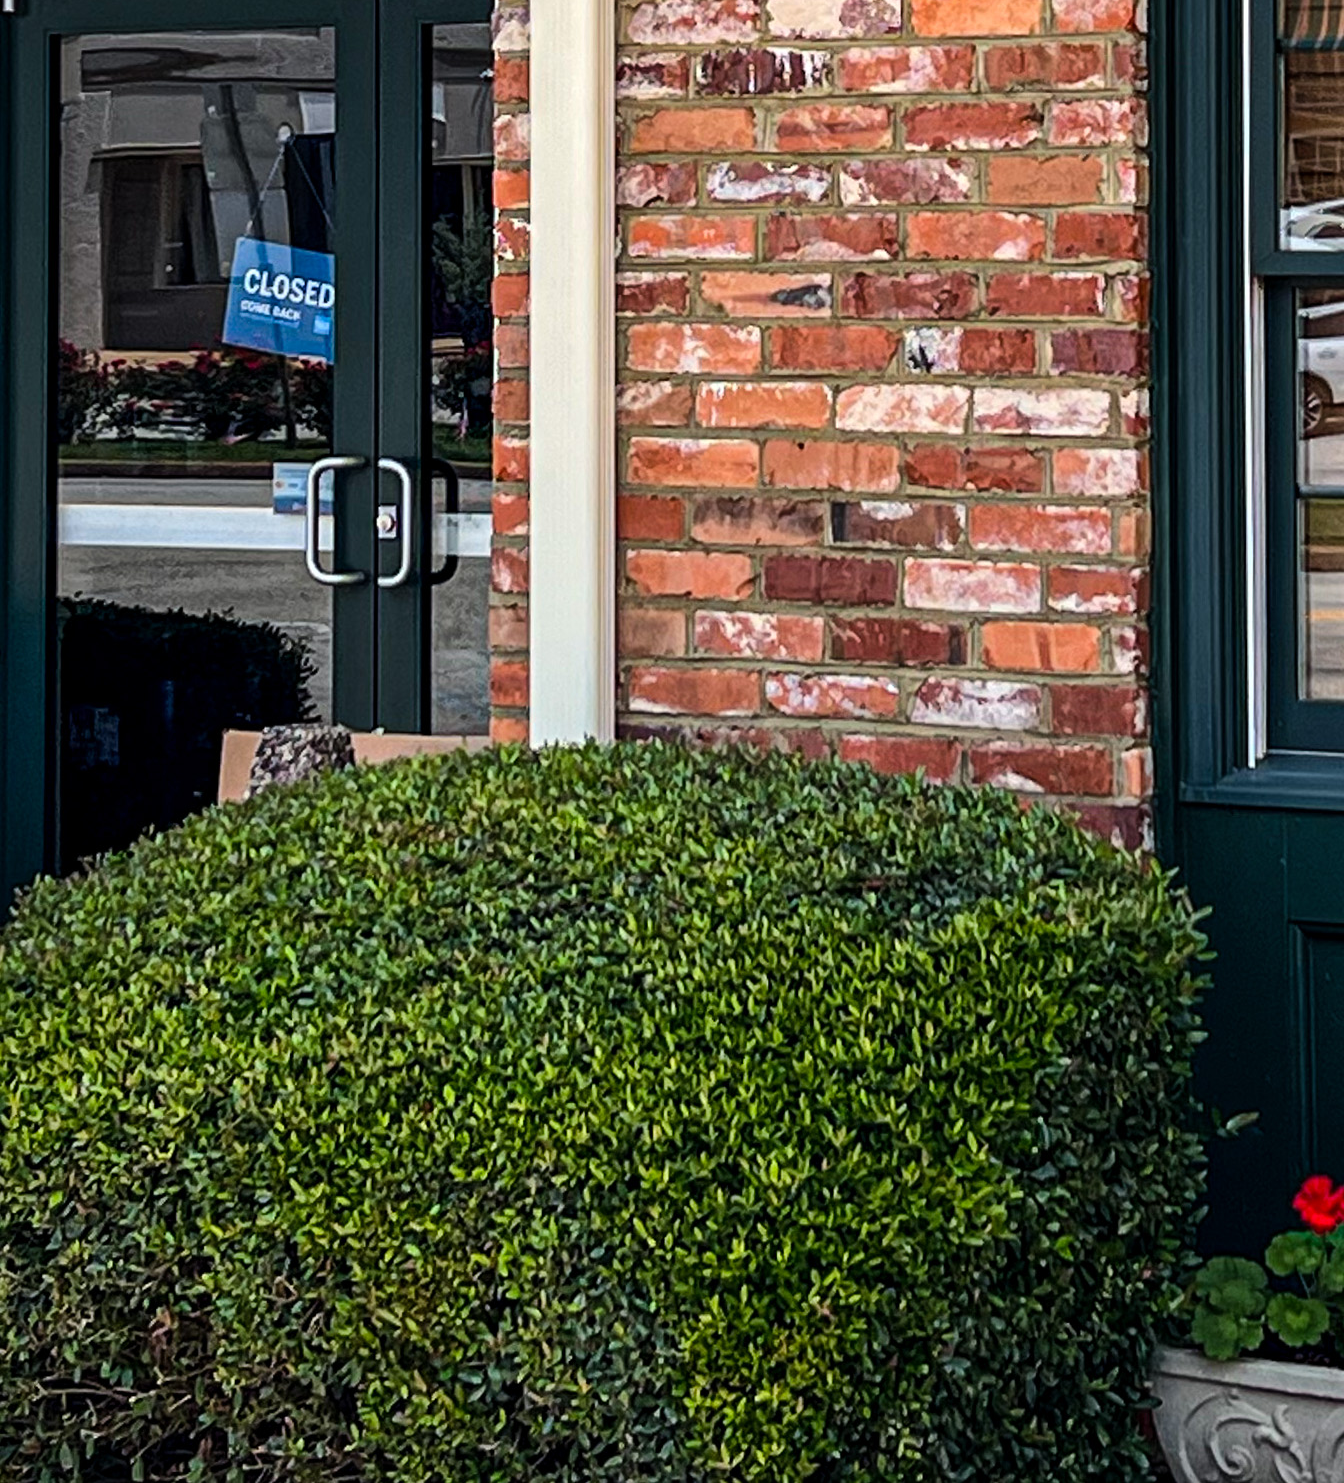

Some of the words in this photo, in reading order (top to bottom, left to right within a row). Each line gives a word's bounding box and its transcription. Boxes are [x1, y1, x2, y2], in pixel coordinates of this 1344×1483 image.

[243, 267, 336, 309] CLOSED
[240, 299, 272, 316] COME
[271, 304, 303, 322] BACK
